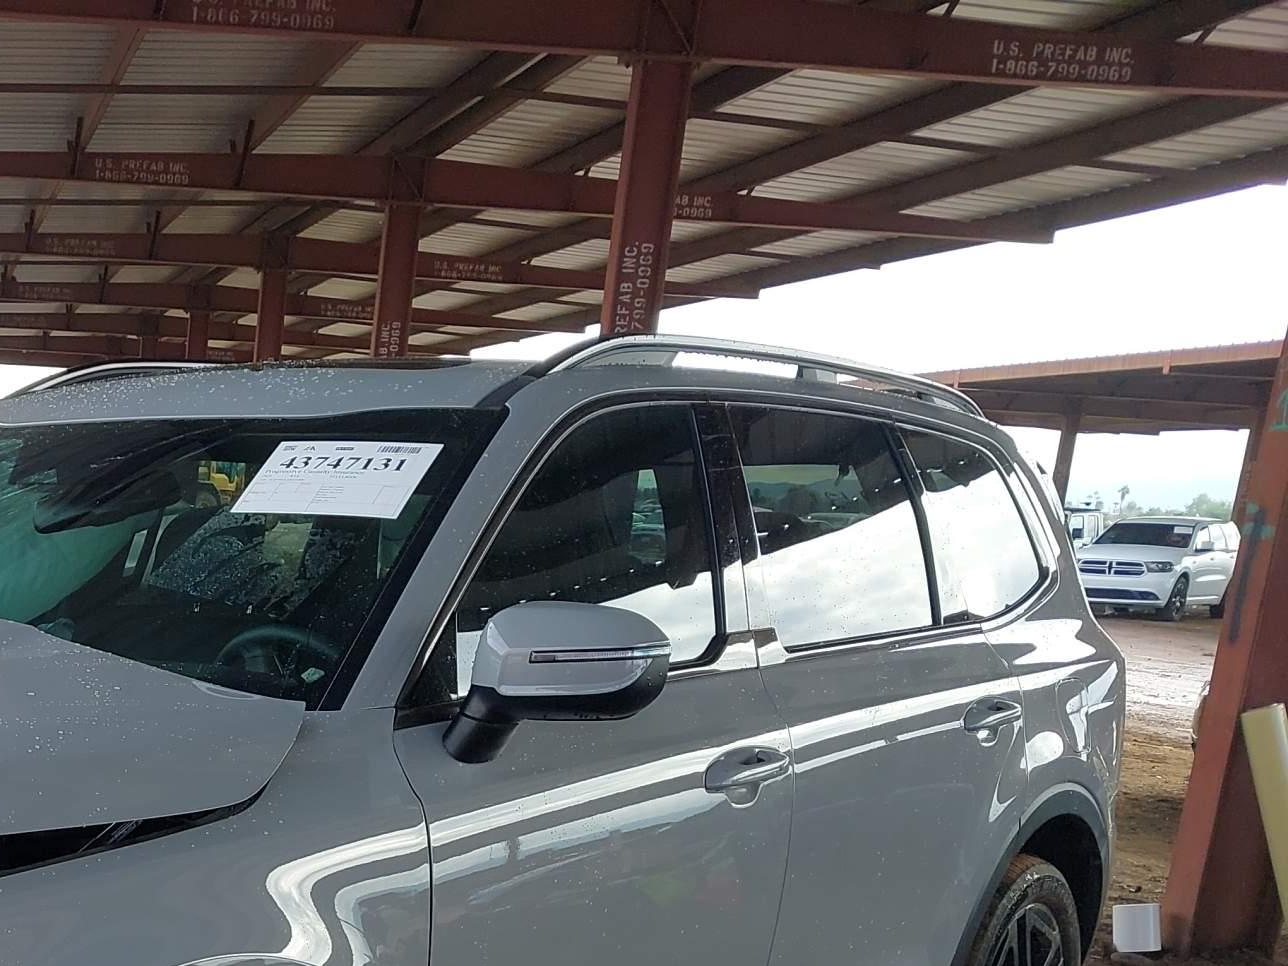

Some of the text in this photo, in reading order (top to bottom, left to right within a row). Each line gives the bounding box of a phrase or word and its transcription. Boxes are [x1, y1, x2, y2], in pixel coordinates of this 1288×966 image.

[994, 40, 1134, 64] U.S. PREFAB INC.
[992, 58, 1132, 81] 1-866-799-0969
[122, 160, 164, 172] PREFAB
[614, 241, 640, 333] REFAB INC.
[630, 242, 654, 330] 799-0969
[280, 456, 408, 472] 43747131
